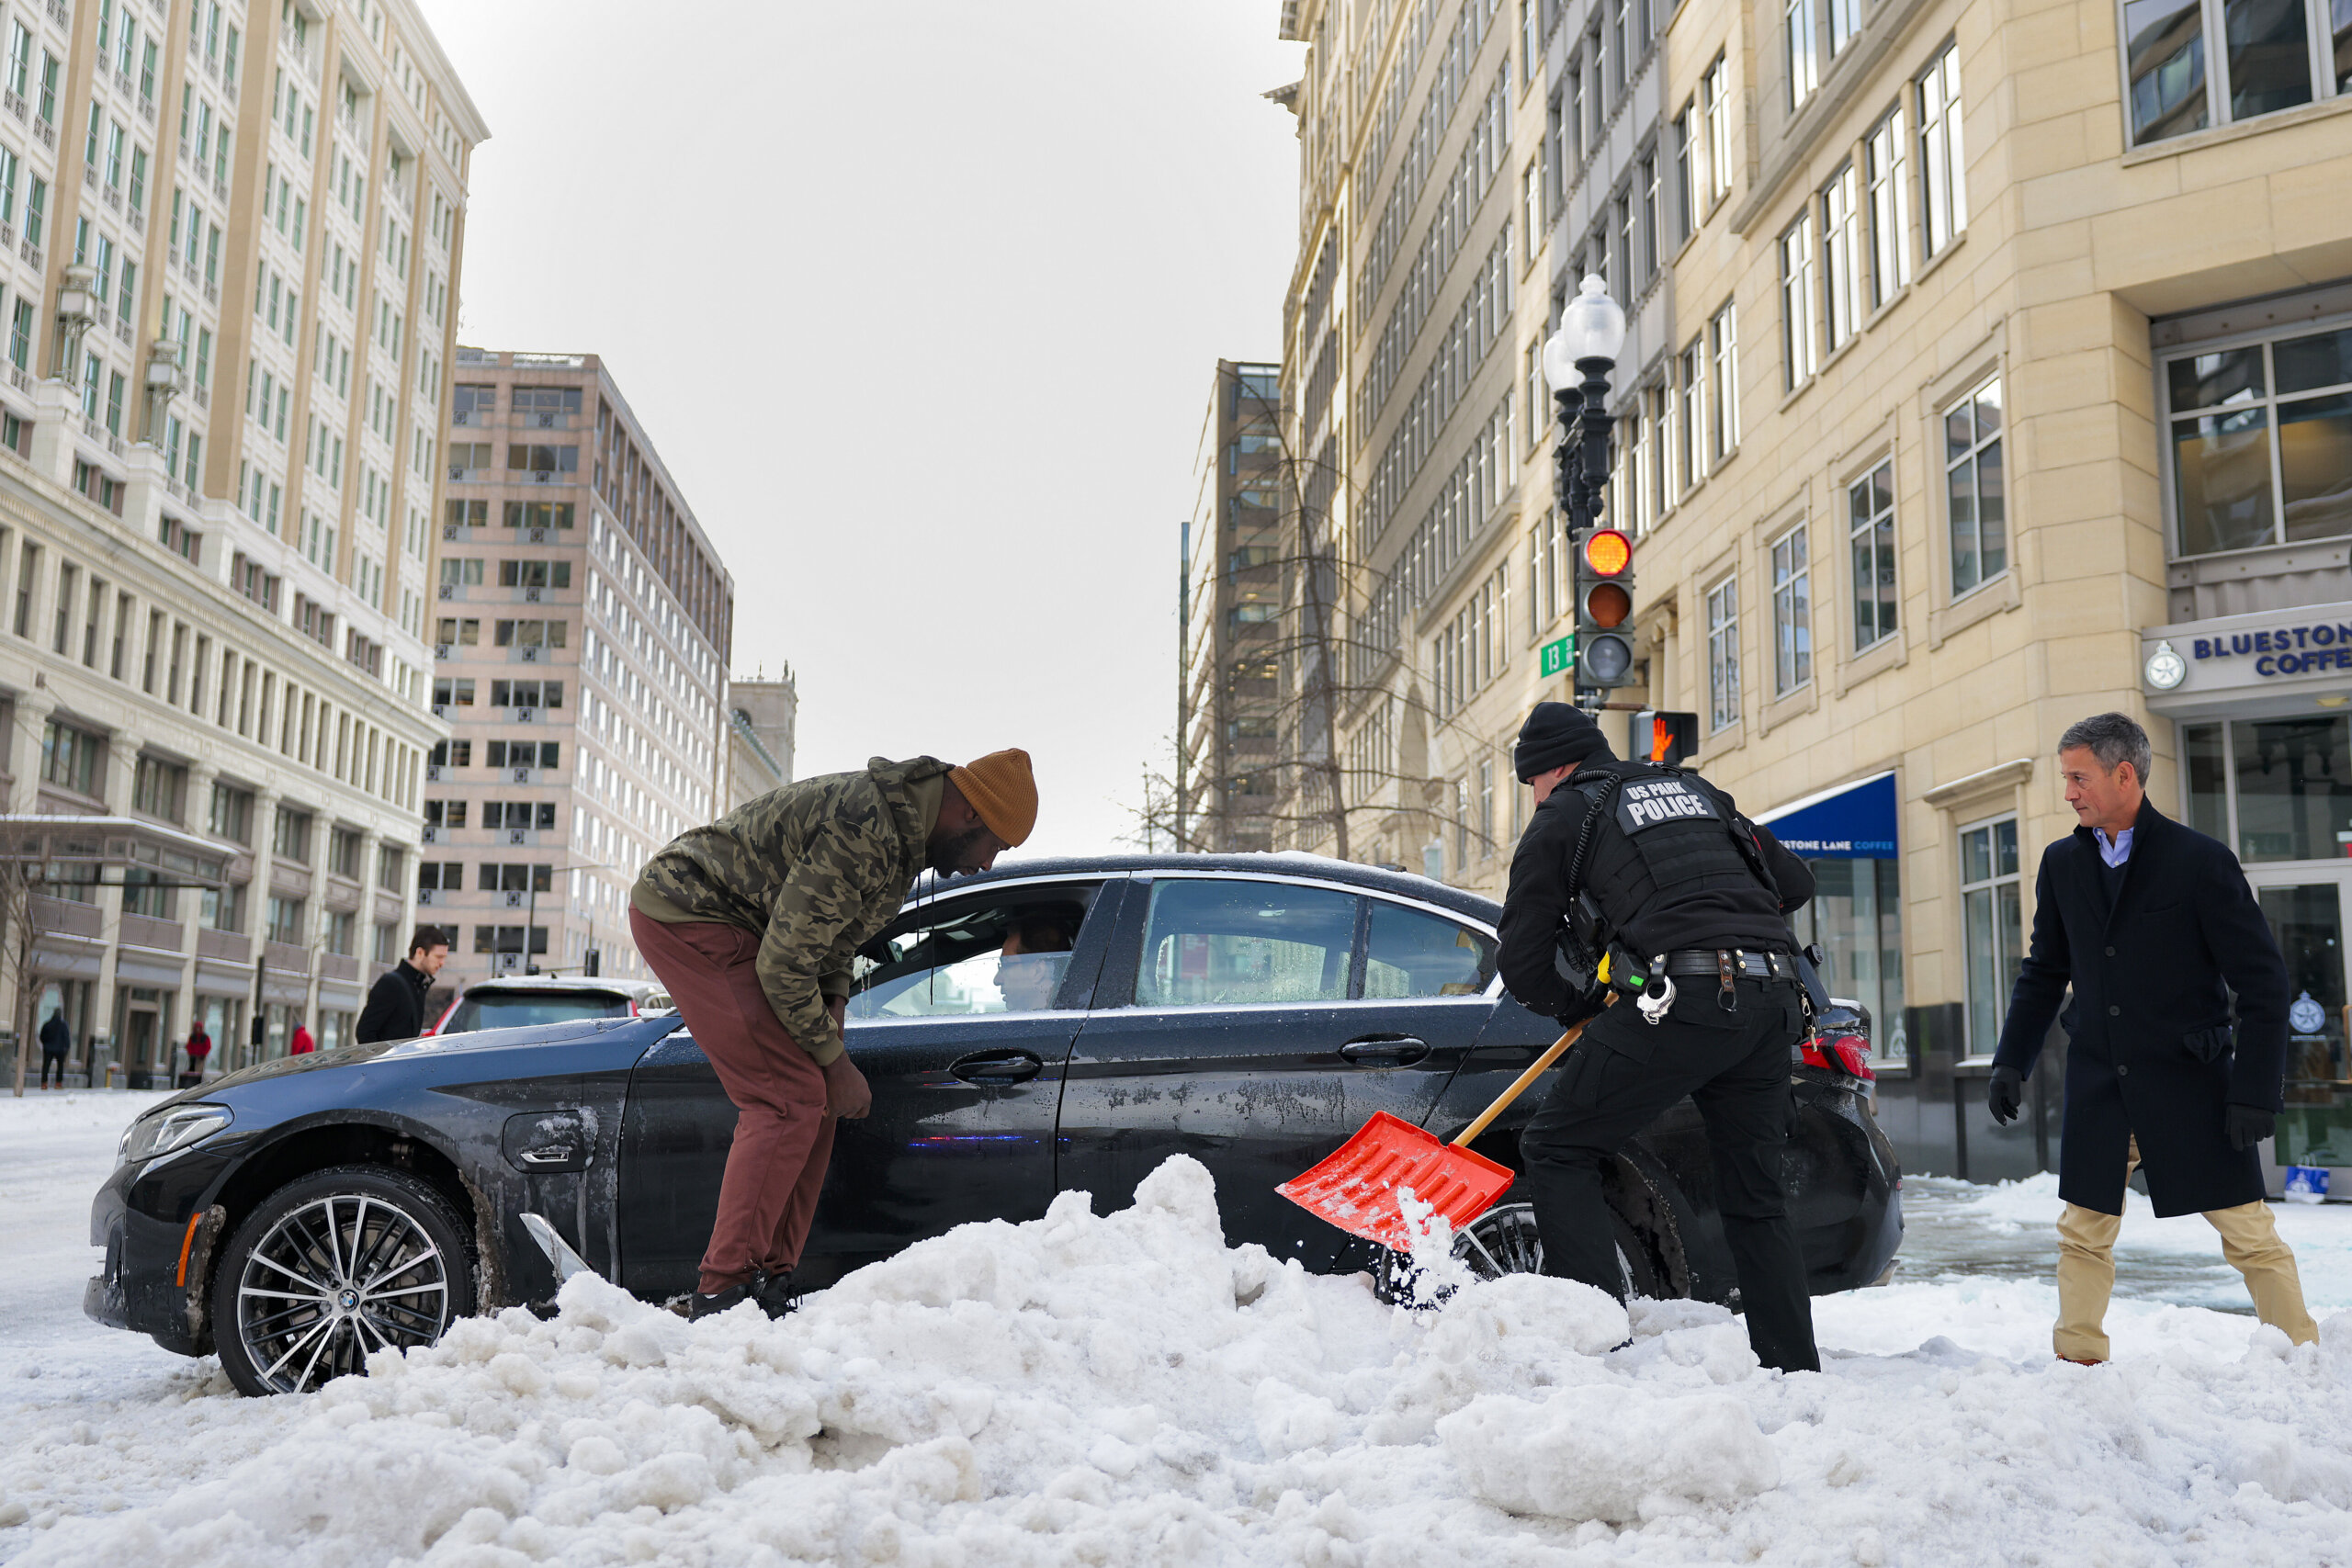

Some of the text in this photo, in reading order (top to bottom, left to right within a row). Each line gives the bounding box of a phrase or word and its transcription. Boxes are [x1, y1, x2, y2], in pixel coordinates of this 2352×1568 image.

[1548, 645, 1559, 671] 13
[1626, 782, 1687, 800] US PARK
[1626, 795, 1708, 827] POLICE
[1822, 840, 1851, 851] LANE
[1854, 841, 1894, 850] COFFEE
